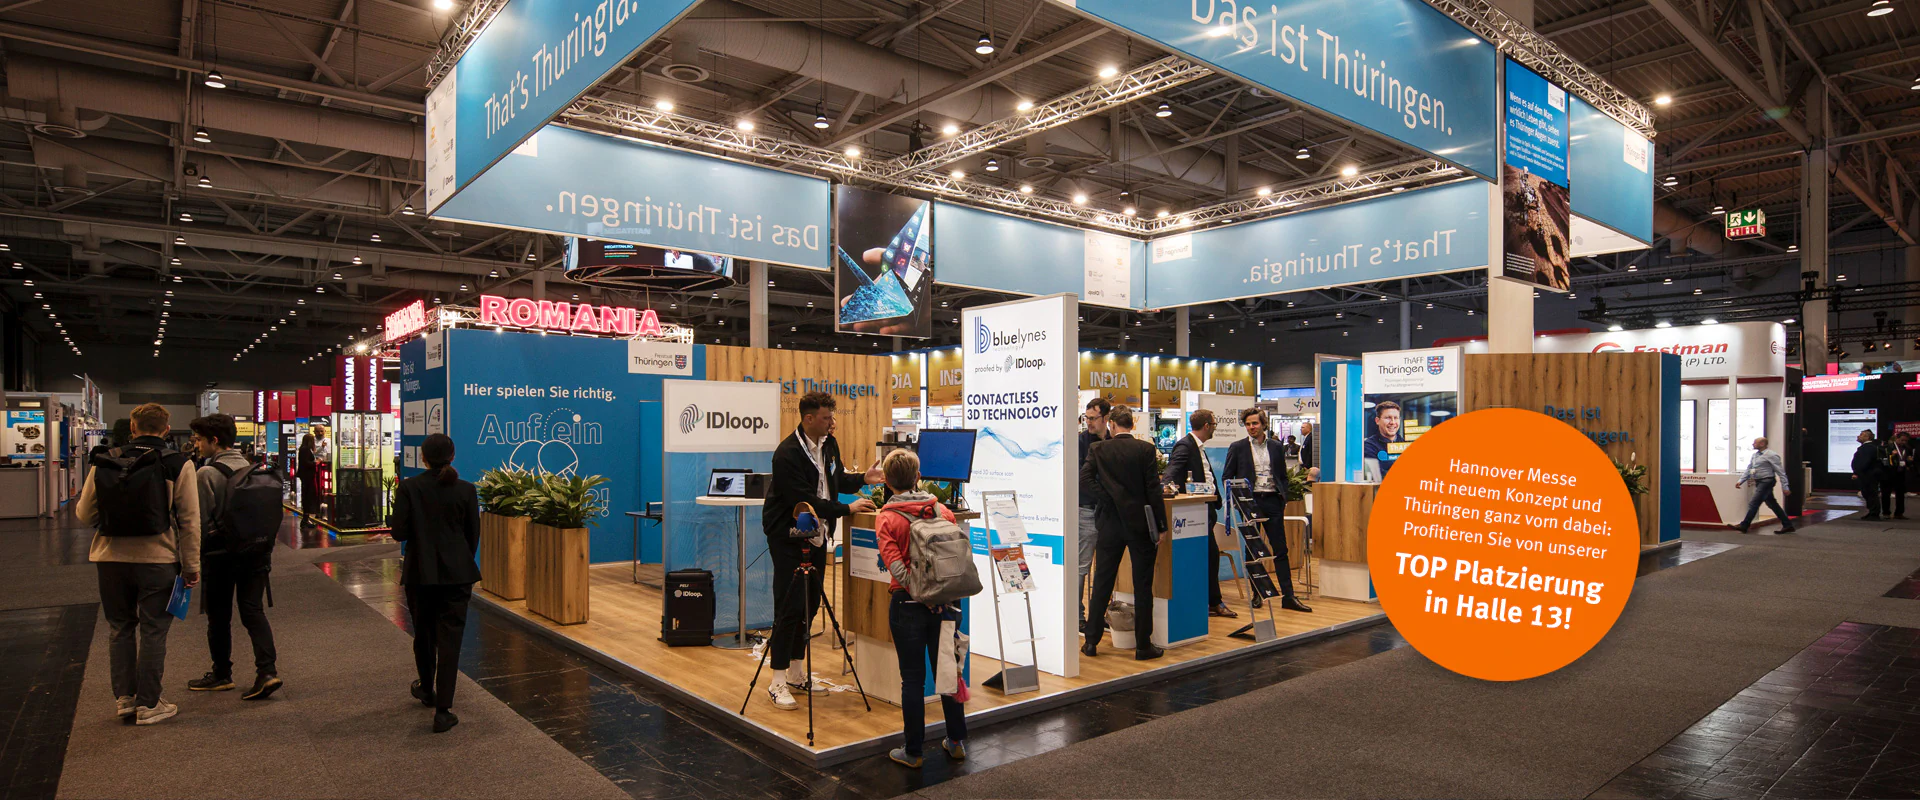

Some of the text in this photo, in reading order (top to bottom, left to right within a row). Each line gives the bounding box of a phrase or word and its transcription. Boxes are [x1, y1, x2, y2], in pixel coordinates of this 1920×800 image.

[1271, 4, 1308, 72] ist
[1316, 28, 1452, 136] Thüringen.
[1510, 91, 1521, 104] Wenn
[1522, 100, 1527, 108] es
[1534, 105, 1543, 115] dem
[1544, 109, 1553, 121] Mars
[1510, 106, 1526, 119] wirklich
[1526, 111, 1539, 124] Leben
[1548, 124, 1560, 136] sehen
[1510, 120, 1515, 128] es
[1516, 119, 1535, 136] Thüringer
[1535, 129, 1547, 142] Augen
[480, 295, 664, 336] ROMANIA
[993, 328, 1047, 349] bluelynes
[1633, 343, 1729, 356] Eastman
[634, 356, 673, 369] Thüringen
[975, 364, 995, 373] proofed
[996, 364, 1002, 373] by
[1378, 365, 1424, 376] Thüringen
[1703, 357, 1727, 365] LTD.
[346, 357, 354, 411] ROMANIA
[464, 384, 617, 402] Hier spielen Sie richtig.
[779, 377, 798, 394] ist
[802, 378, 880, 400] Thüringen.
[967, 391, 1039, 406] CONTACTLESS
[967, 406, 1058, 420] 3D TECHNOLOGY
[1544, 405, 1601, 420] Das ist
[477, 413, 603, 445] Auf ein
